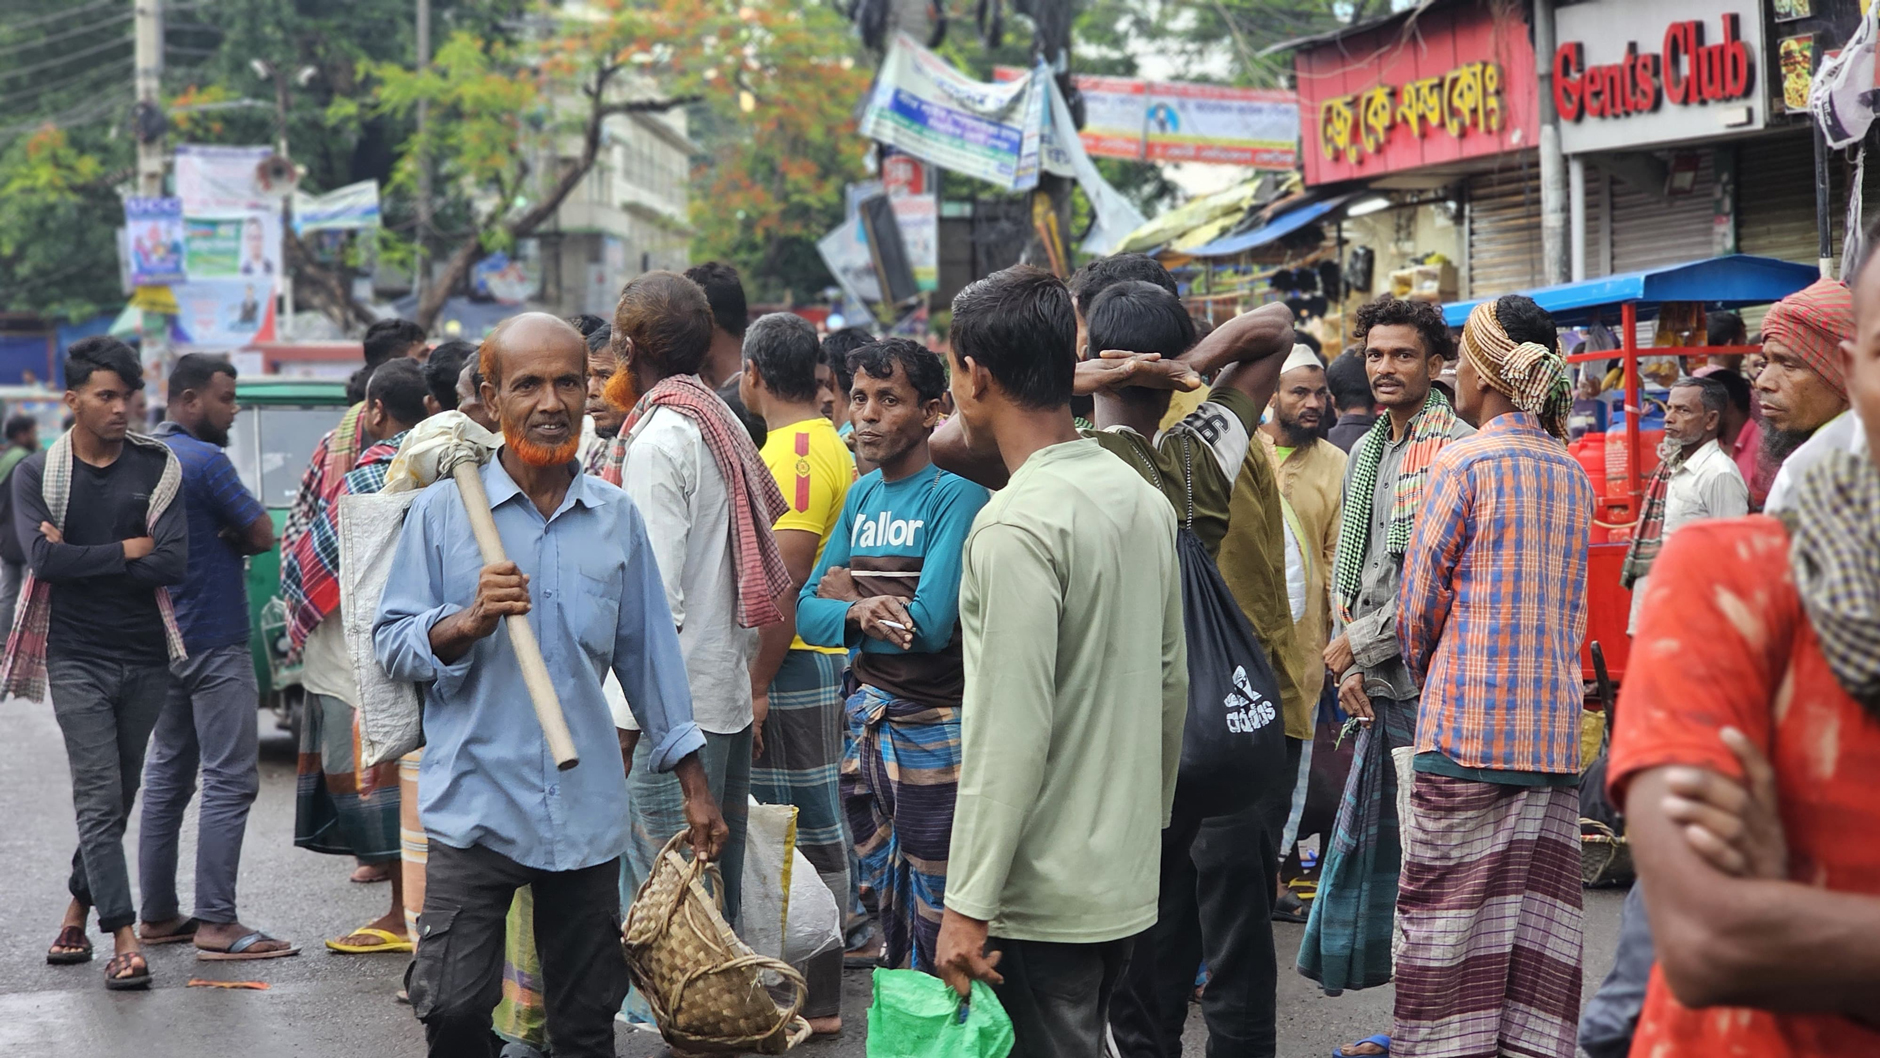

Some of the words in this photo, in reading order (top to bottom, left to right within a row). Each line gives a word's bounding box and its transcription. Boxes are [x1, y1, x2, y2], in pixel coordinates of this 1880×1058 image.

[1553, 41, 1660, 121] Gents
[1663, 13, 1753, 105] Club
[1226, 700, 1276, 733] addas
